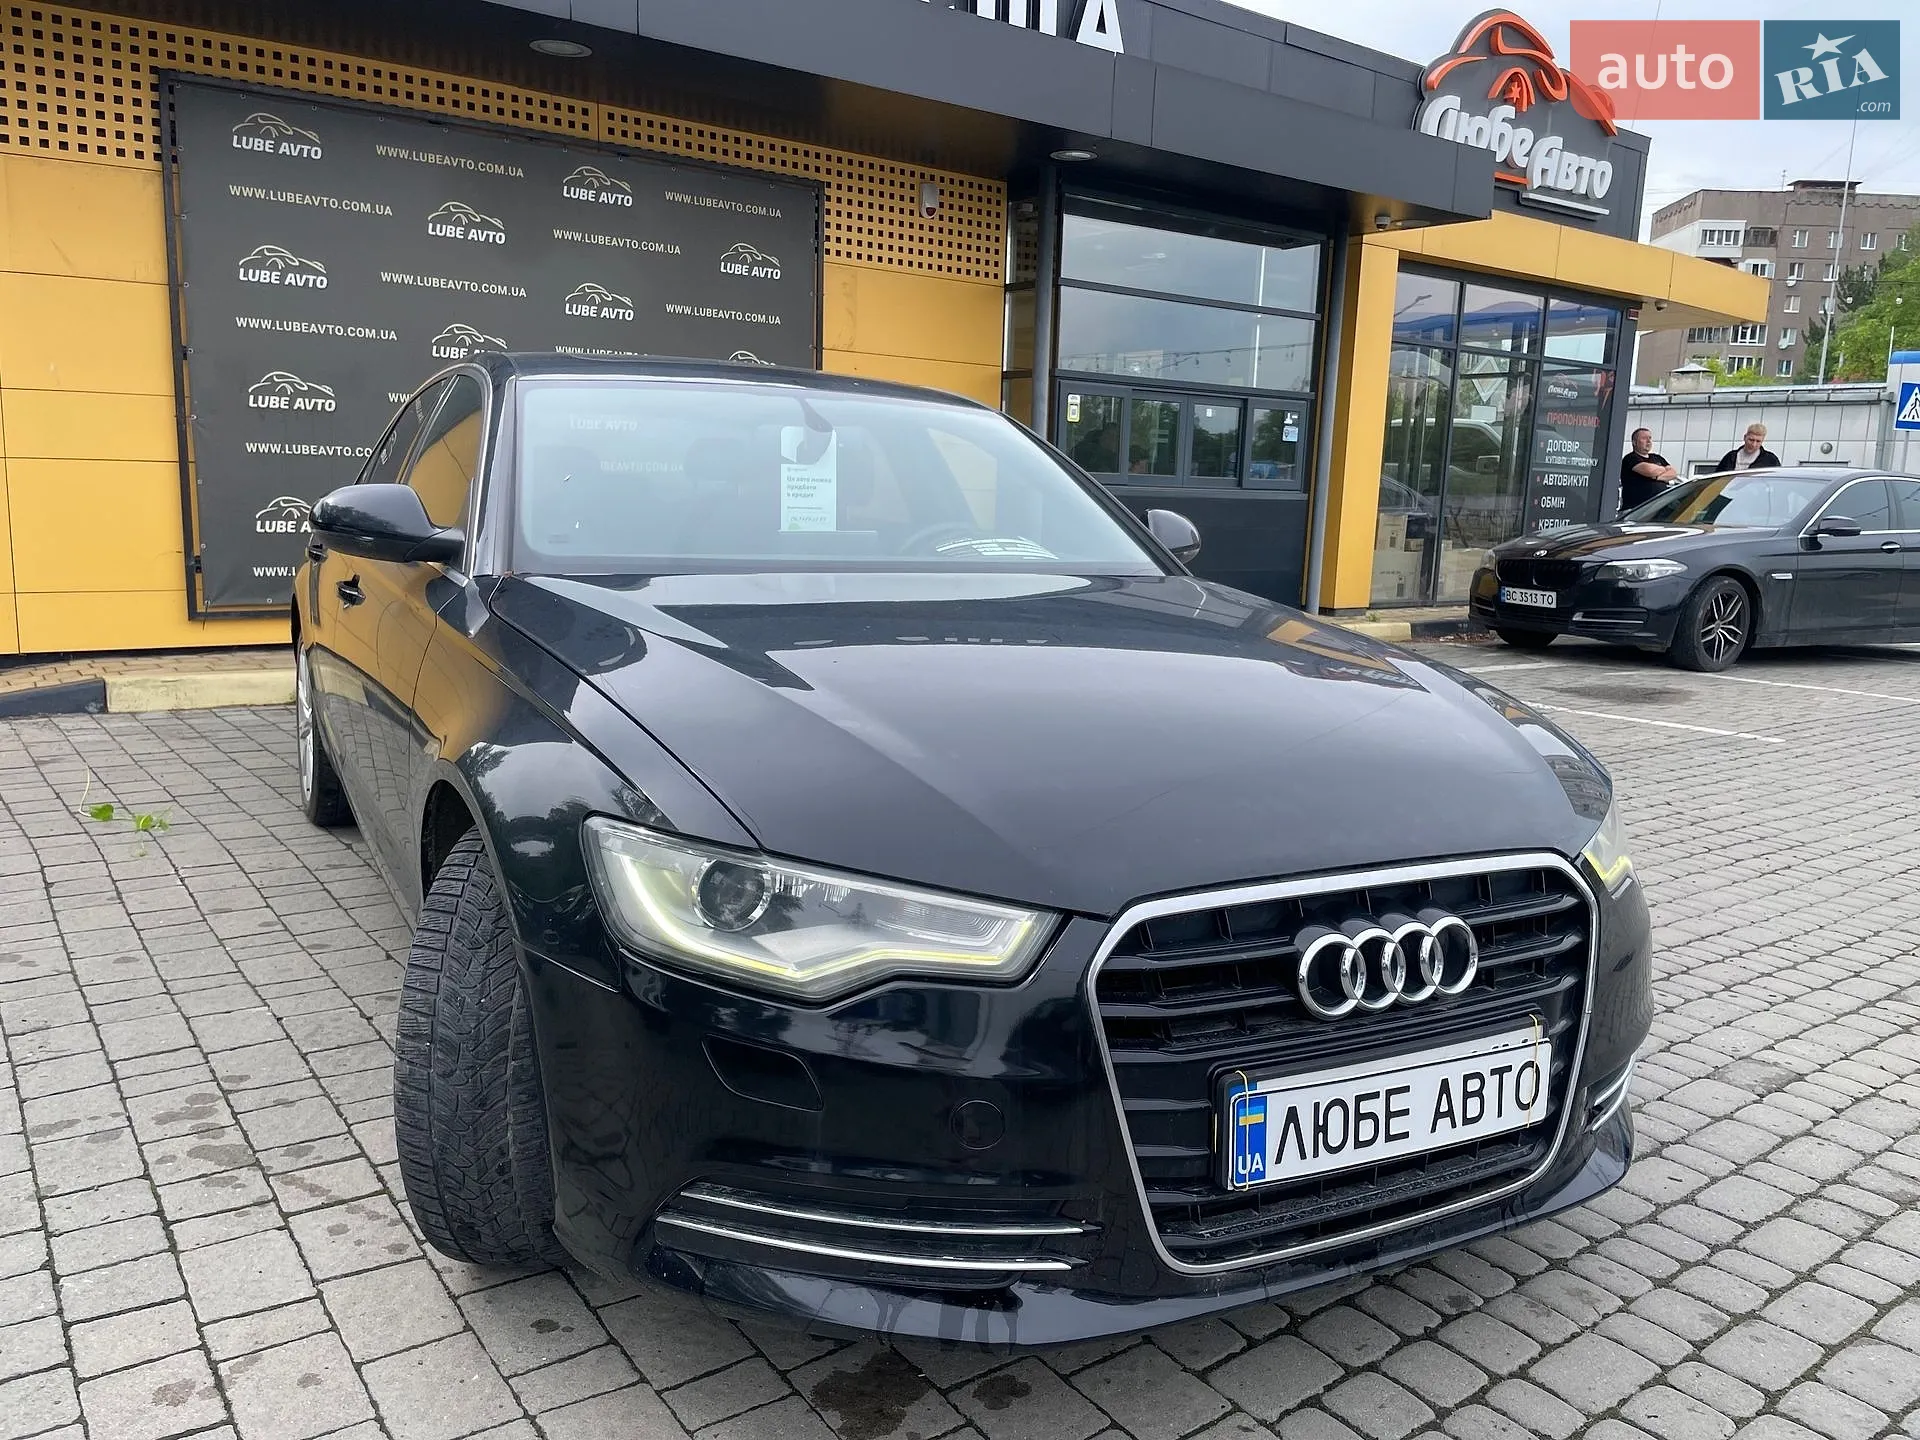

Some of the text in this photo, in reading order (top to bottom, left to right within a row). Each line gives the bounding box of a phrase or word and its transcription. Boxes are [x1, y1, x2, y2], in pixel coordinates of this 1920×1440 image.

[232, 135, 322, 160] LUBE AVTO
[376, 145, 525, 178] WWW.LUBEAVTO.COM.UA
[229, 185, 393, 217] WWW.LUBEAVTO.COM.UA
[563, 185, 633, 207] LUBE AVTO
[664, 191, 782, 218] WWW.LUBEAVTO.COM.UA
[427, 223, 507, 245] LUBE AVTO
[553, 229, 681, 255] WWW.LUBEAVTO.COM.UA
[238, 267, 328, 289] LUBE AVTO
[720, 261, 781, 280] LUBE AVTO
[380, 271, 528, 298] WWW.LUBEAVTO.COM.UA
[565, 303, 634, 321] LUBE AVTO
[665, 303, 781, 325] WWW.LUBEAVTO.COM.UA
[235, 316, 398, 341] WWW.LUBEAVTO.COM.UA
[248, 395, 336, 412] LUBE AVTO
[246, 442, 372, 458] WWW.LUBEAVTO.CO
[1546, 440, 1580, 453] ДОГОВІР
[1543, 474, 1589, 487] АВТОВИКУП
[1541, 496, 1566, 508] ОБМІН
[255, 520, 297, 533] LUBE
[1506, 590, 1517, 601] BC
[1519, 592, 1538, 605] 3513
[1540, 594, 1554, 605] TO
[1275, 1060, 1541, 1165] ЛЮБЕ АВТО
[1238, 1154, 1264, 1175] UA
